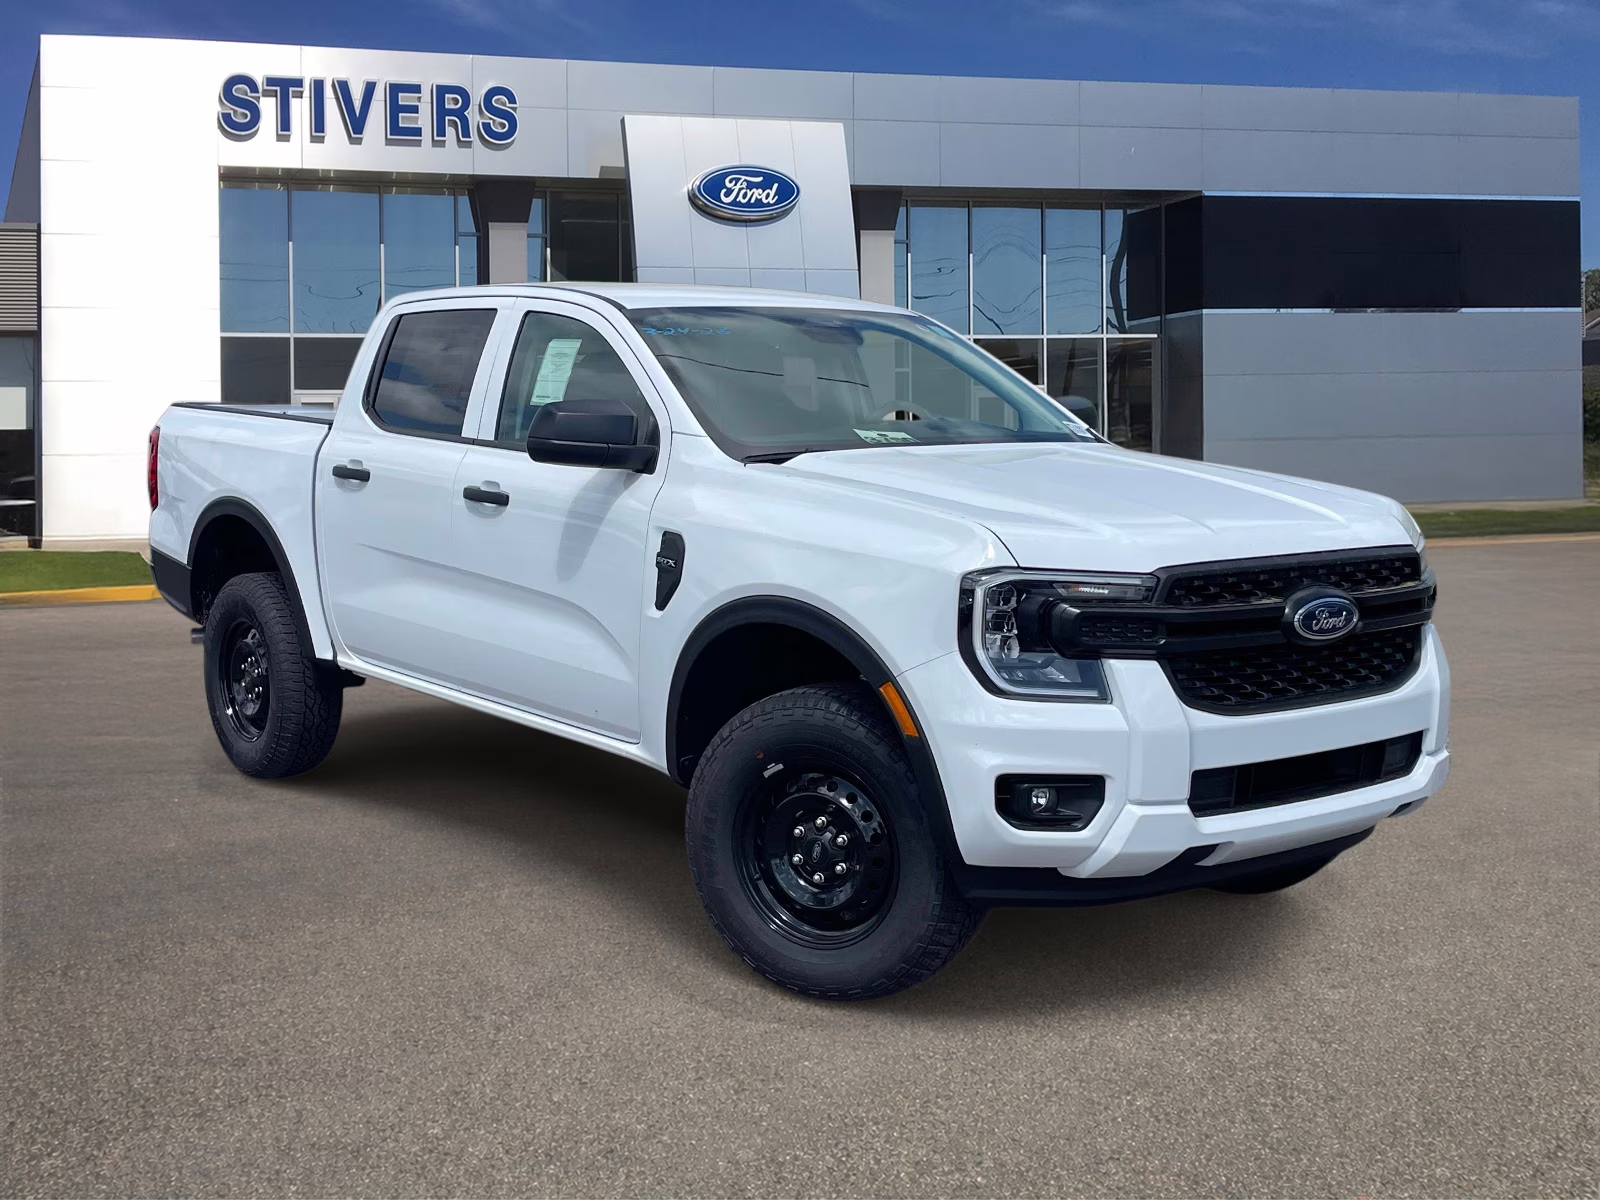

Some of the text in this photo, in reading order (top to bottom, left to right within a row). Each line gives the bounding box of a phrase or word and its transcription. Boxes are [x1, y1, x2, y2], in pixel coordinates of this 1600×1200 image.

[218, 73, 519, 145] STIVERS
[720, 174, 779, 204] Ford
[1312, 605, 1346, 631] Ford
